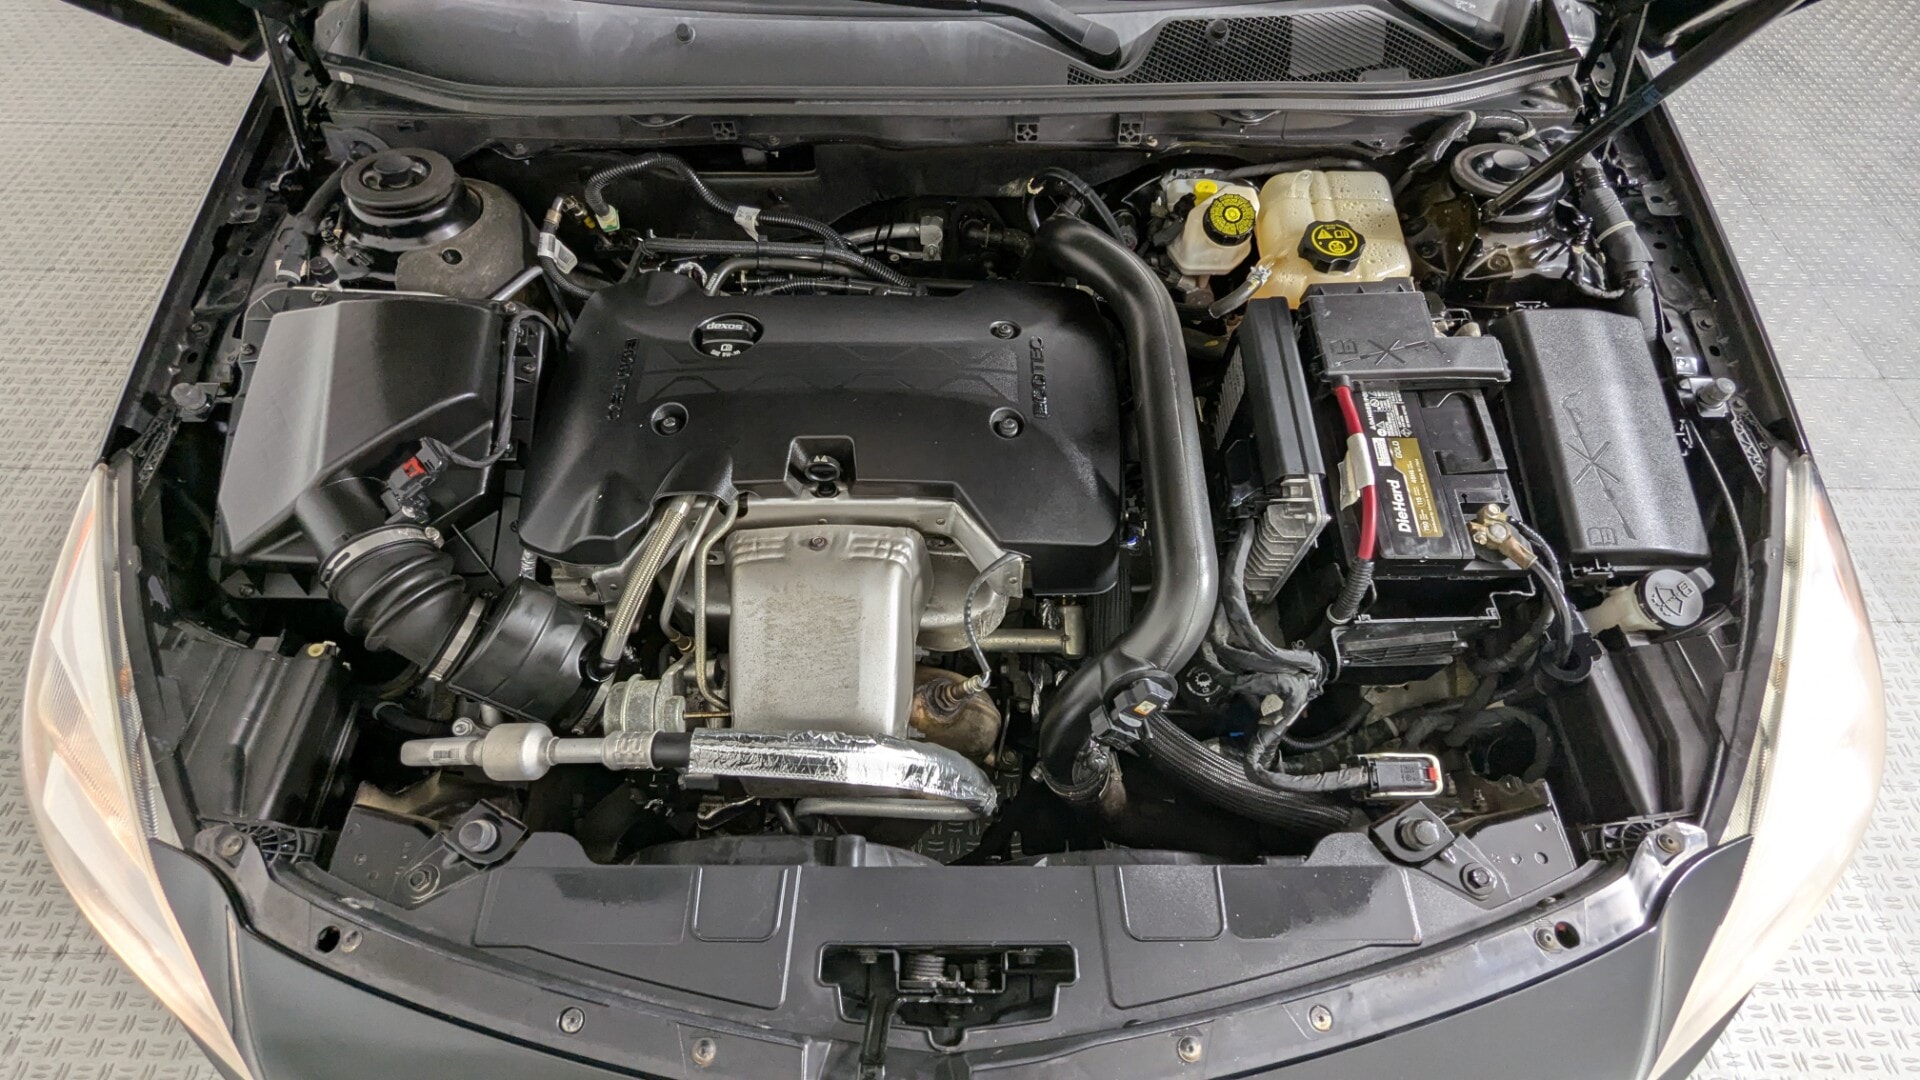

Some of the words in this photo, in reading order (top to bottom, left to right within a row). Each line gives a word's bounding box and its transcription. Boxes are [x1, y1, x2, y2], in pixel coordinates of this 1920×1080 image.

[706, 322, 743, 330] dexos
[1030, 335, 1049, 419] ECOTEC
[1392, 440, 1403, 459] GOLD
[1386, 479, 1412, 533] DieHard
